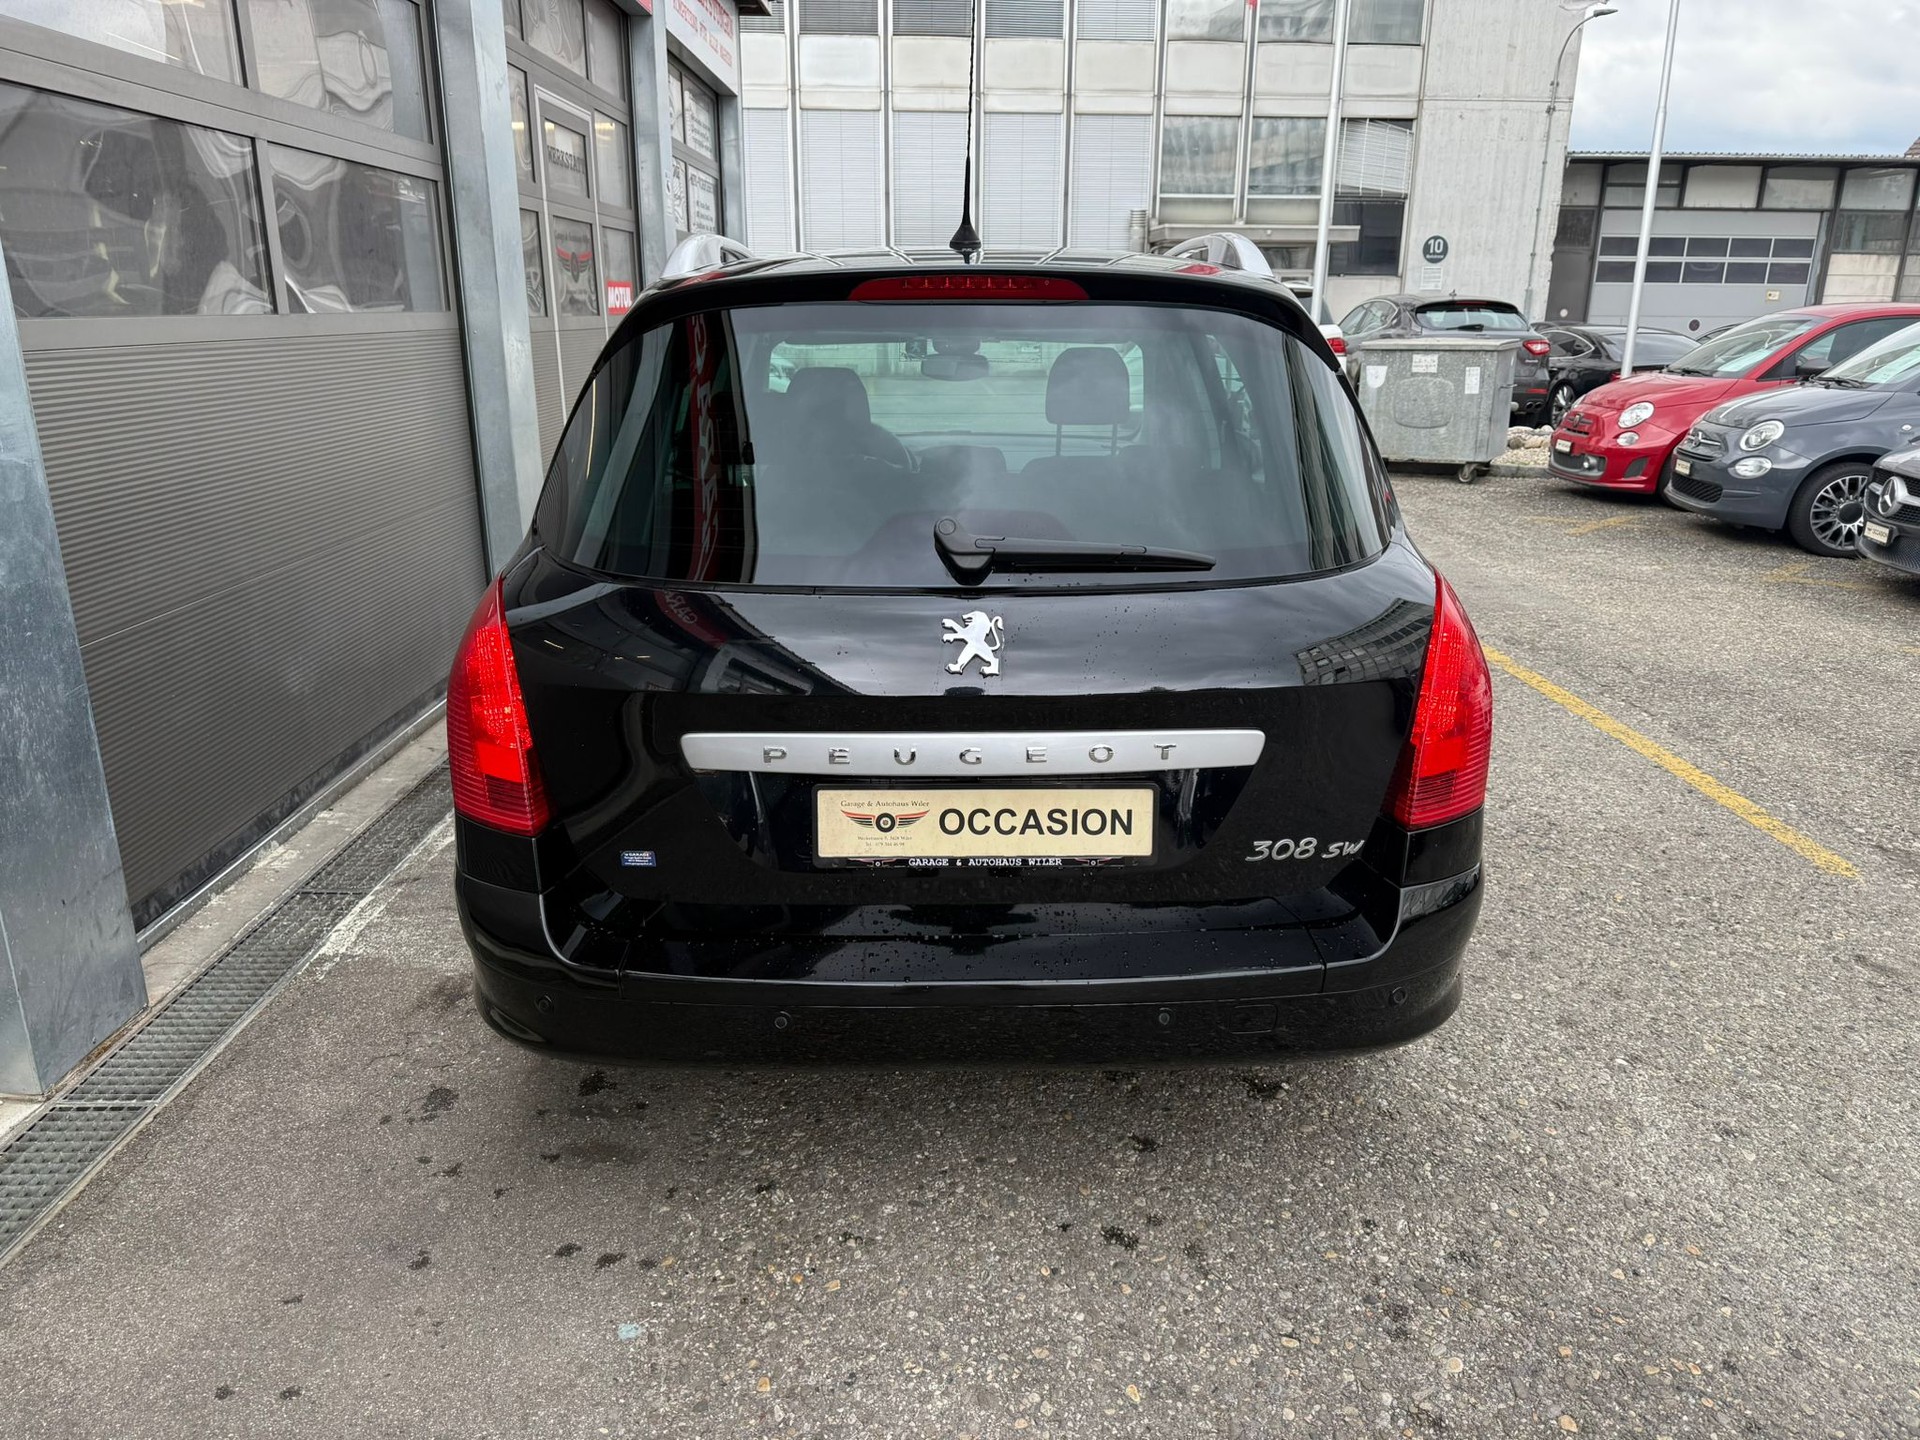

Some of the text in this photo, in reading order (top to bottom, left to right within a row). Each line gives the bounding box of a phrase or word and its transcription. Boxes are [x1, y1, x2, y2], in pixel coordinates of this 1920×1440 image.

[1427, 238, 1444, 254] 10
[607, 287, 633, 308] MOTUL
[762, 742, 1177, 767] PEUGEOT
[938, 808, 1133, 836] OCCASION
[1245, 837, 1318, 862] 308
[908, 858, 1063, 867] GARAGE & AUTOHAUS WILER
